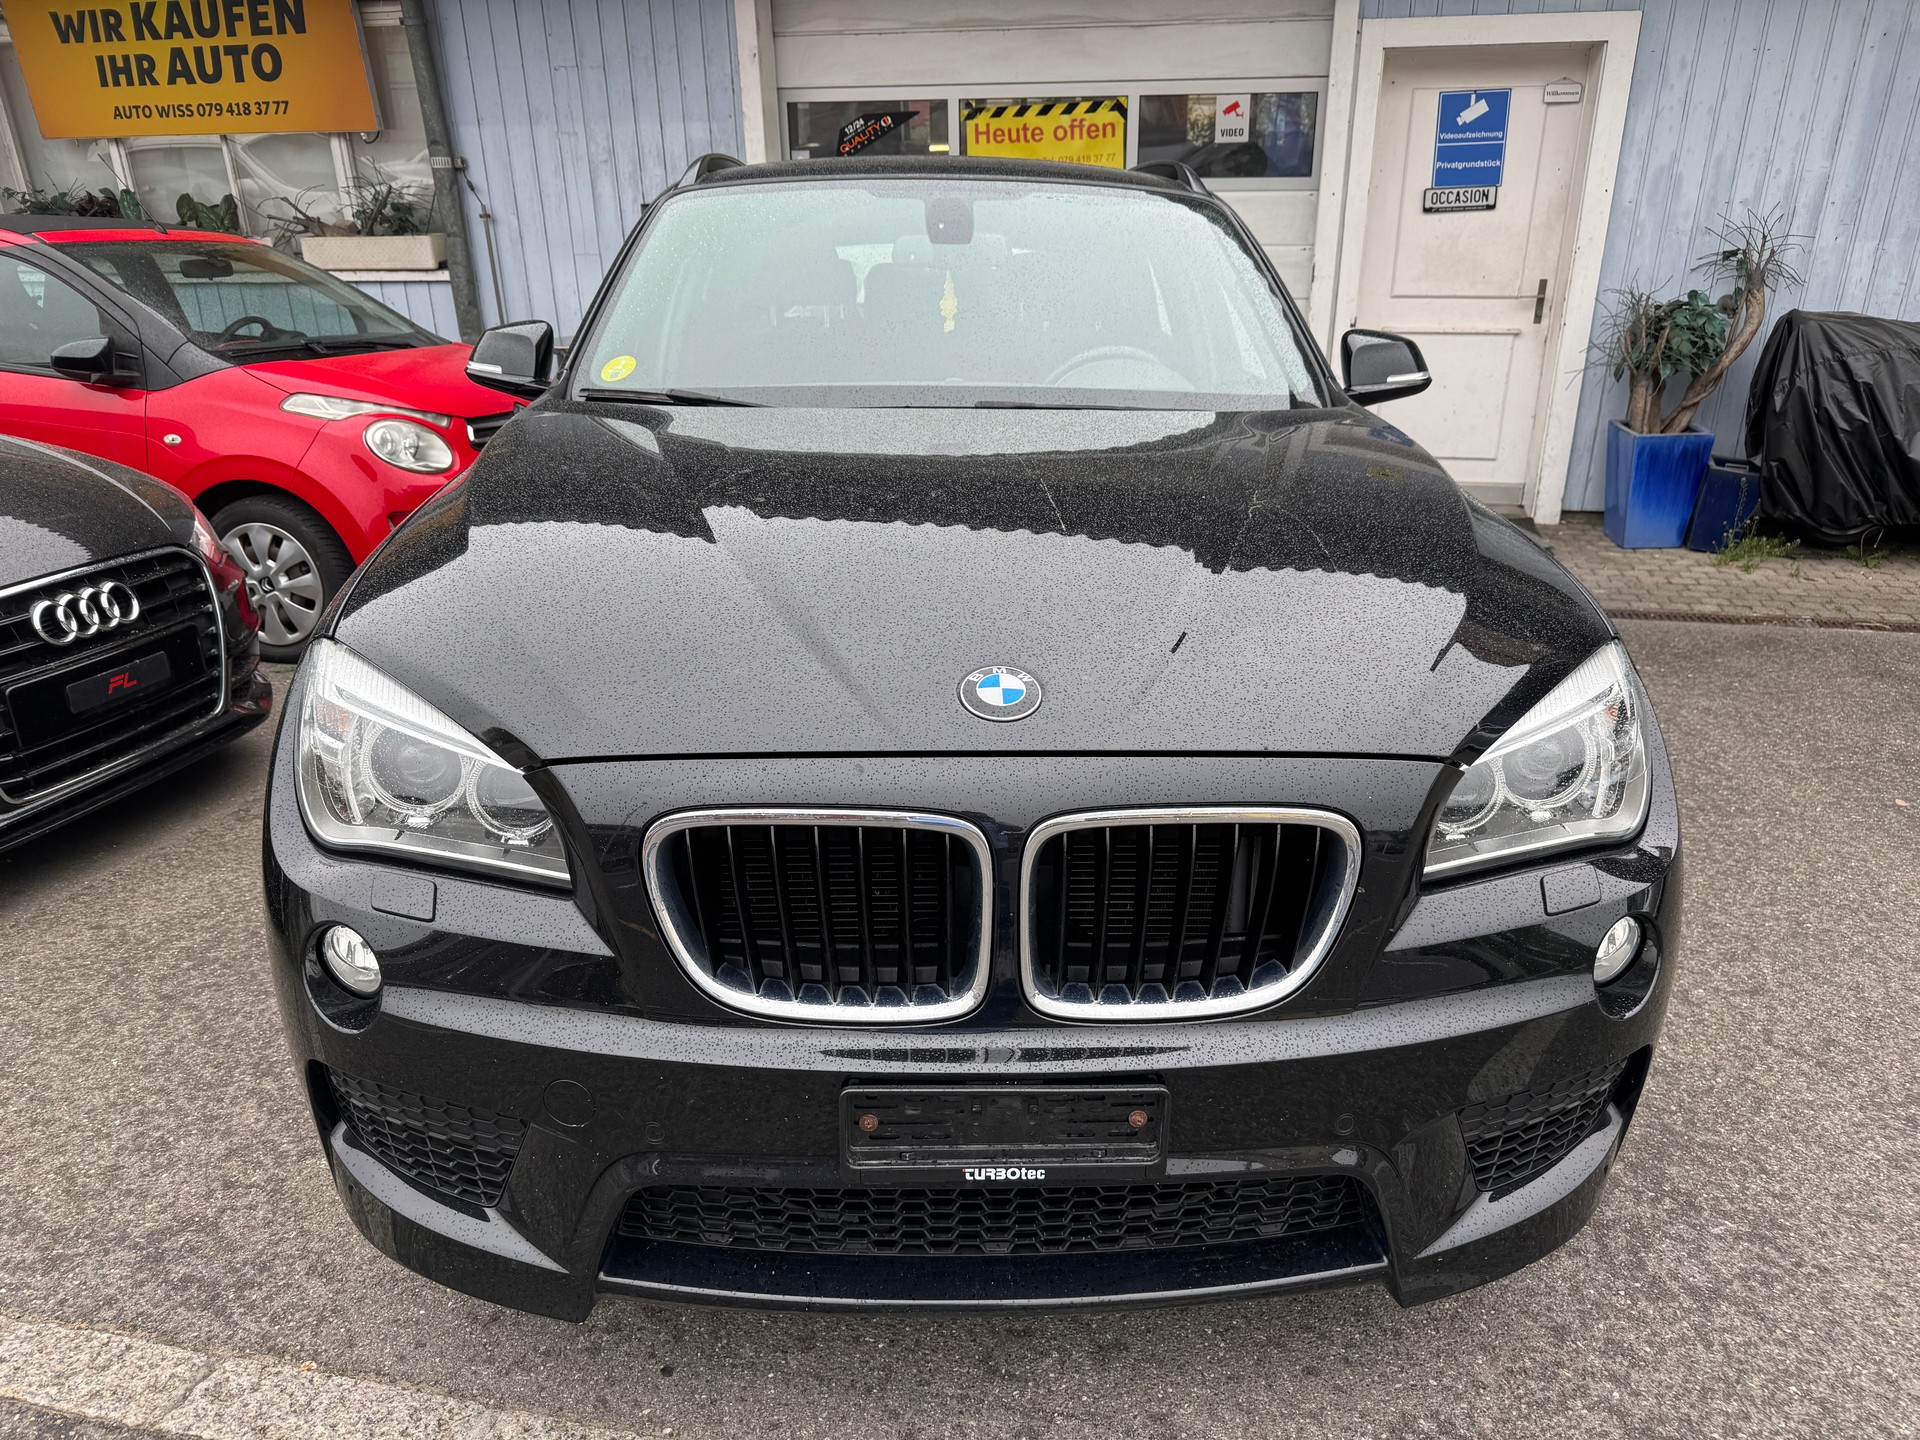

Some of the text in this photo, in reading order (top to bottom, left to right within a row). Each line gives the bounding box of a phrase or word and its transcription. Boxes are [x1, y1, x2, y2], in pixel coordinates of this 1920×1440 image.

[48, 0, 307, 44] WIR KAUFEN
[95, 43, 283, 88] IHR AUTO
[113, 105, 152, 120] AUTO
[155, 103, 195, 118] WISS
[196, 102, 223, 117] 079
[225, 101, 252, 116] 418
[844, 118, 865, 135] 12/24
[974, 118, 1116, 145] Heute offen
[1220, 127, 1244, 137] VIDEO
[1439, 130, 1503, 140] Videoaufzeichnung
[840, 121, 881, 153] QUALITY
[1076, 155, 1091, 163] 418
[1093, 153, 1103, 163] 37
[1106, 153, 1116, 161] 77
[1436, 159, 1501, 170] Privatgrundstück
[1431, 188, 1490, 205] OCCASION
[967, 667, 1034, 682] BMW
[962, 1168, 1046, 1180] TURBOtec
